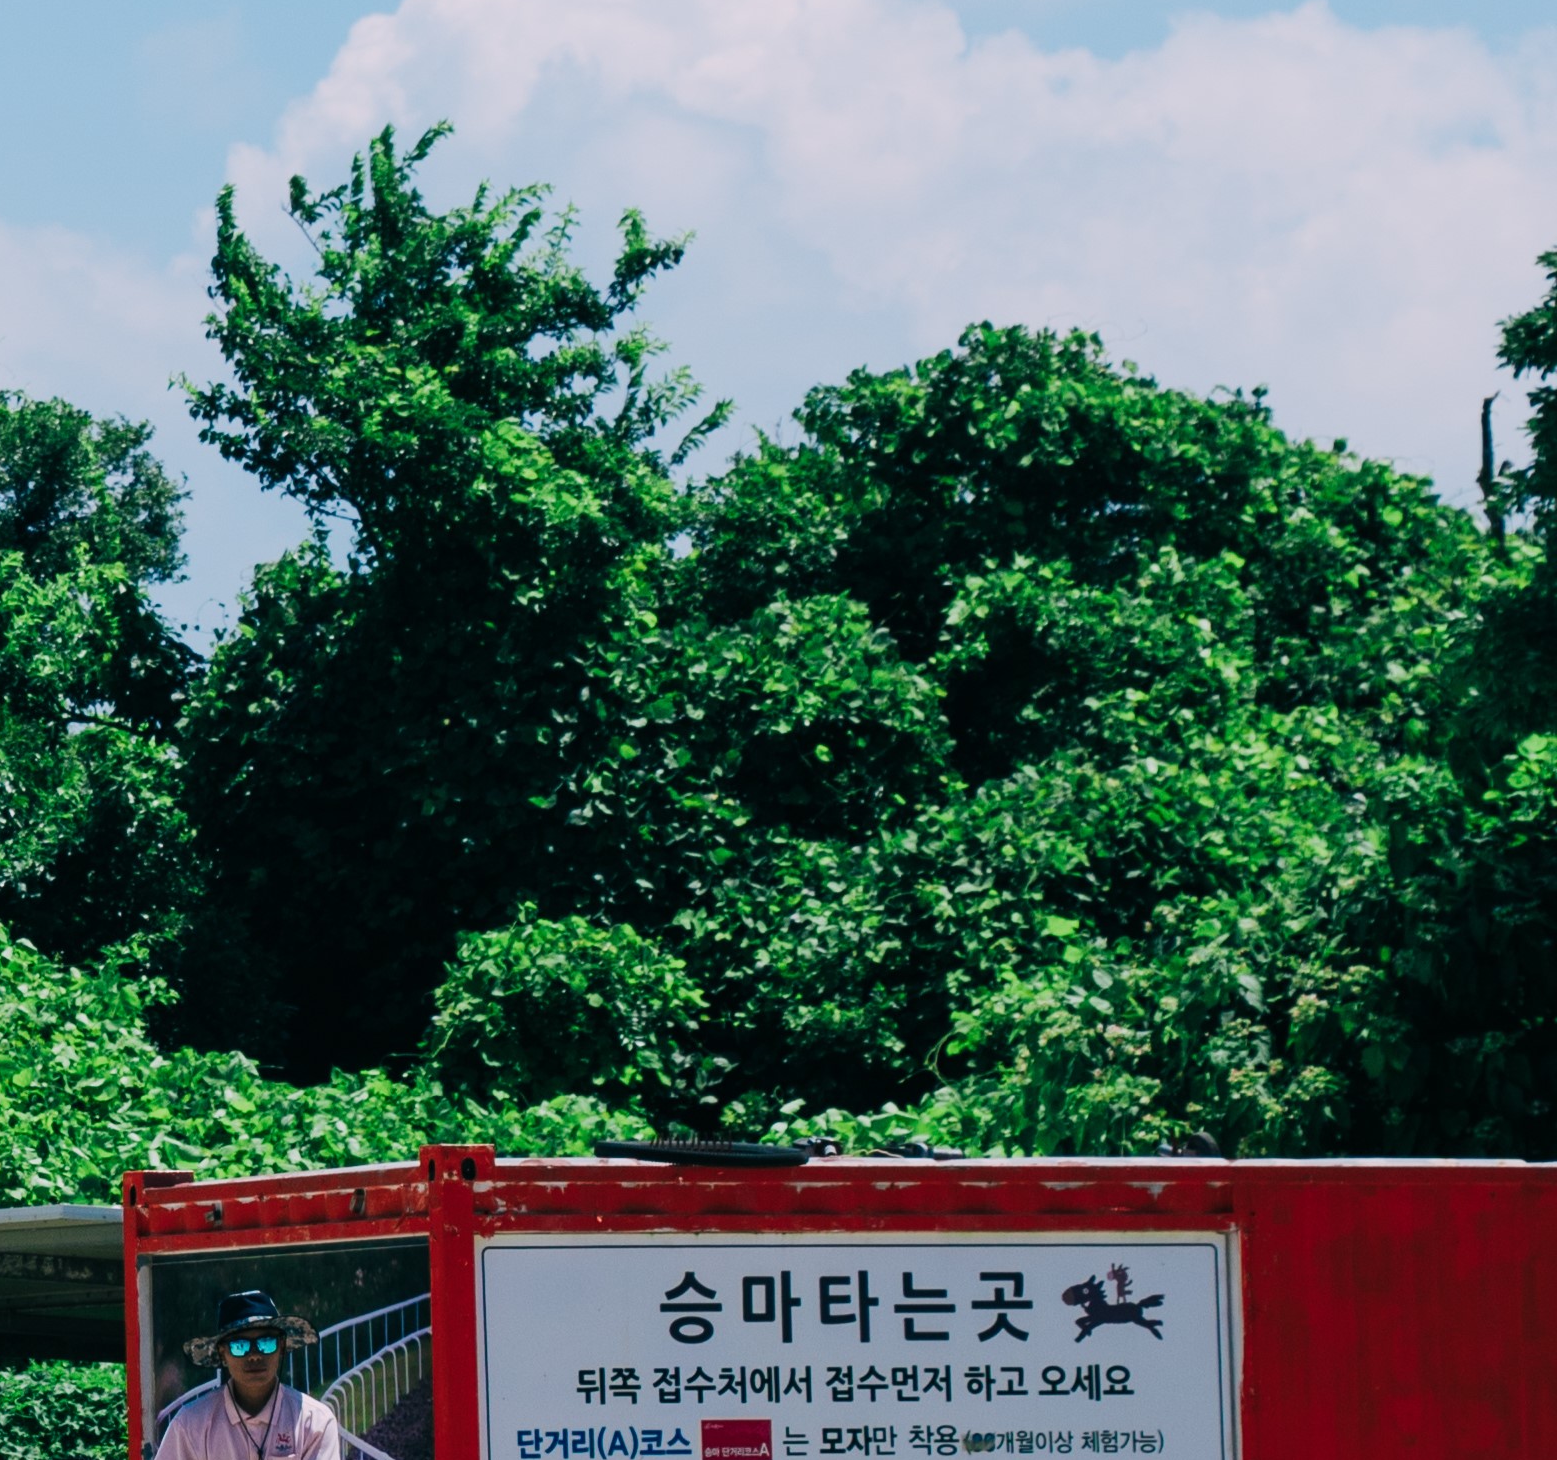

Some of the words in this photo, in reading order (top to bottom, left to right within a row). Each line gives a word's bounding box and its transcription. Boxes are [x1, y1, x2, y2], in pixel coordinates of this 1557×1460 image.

[659, 1271, 1034, 1343] 승마타는곳
[577, 1369, 640, 1404] 뒤쪽
[653, 1367, 814, 1404] 접수처에서
[825, 1366, 952, 1402] 접수먼저
[965, 1366, 1027, 1401] 하고
[1039, 1365, 1134, 1401] 오세요
[517, 1427, 692, 1460] 단거리(A)코스
[784, 1427, 810, 1454] 는
[820, 1426, 896, 1456] 모자만
[909, 1424, 958, 1456] 착용
[963, 1429, 1073, 1455] (개월이상
[1081, 1429, 1164, 1454] 체험가능)
[704, 1447, 719, 1457] 승마
